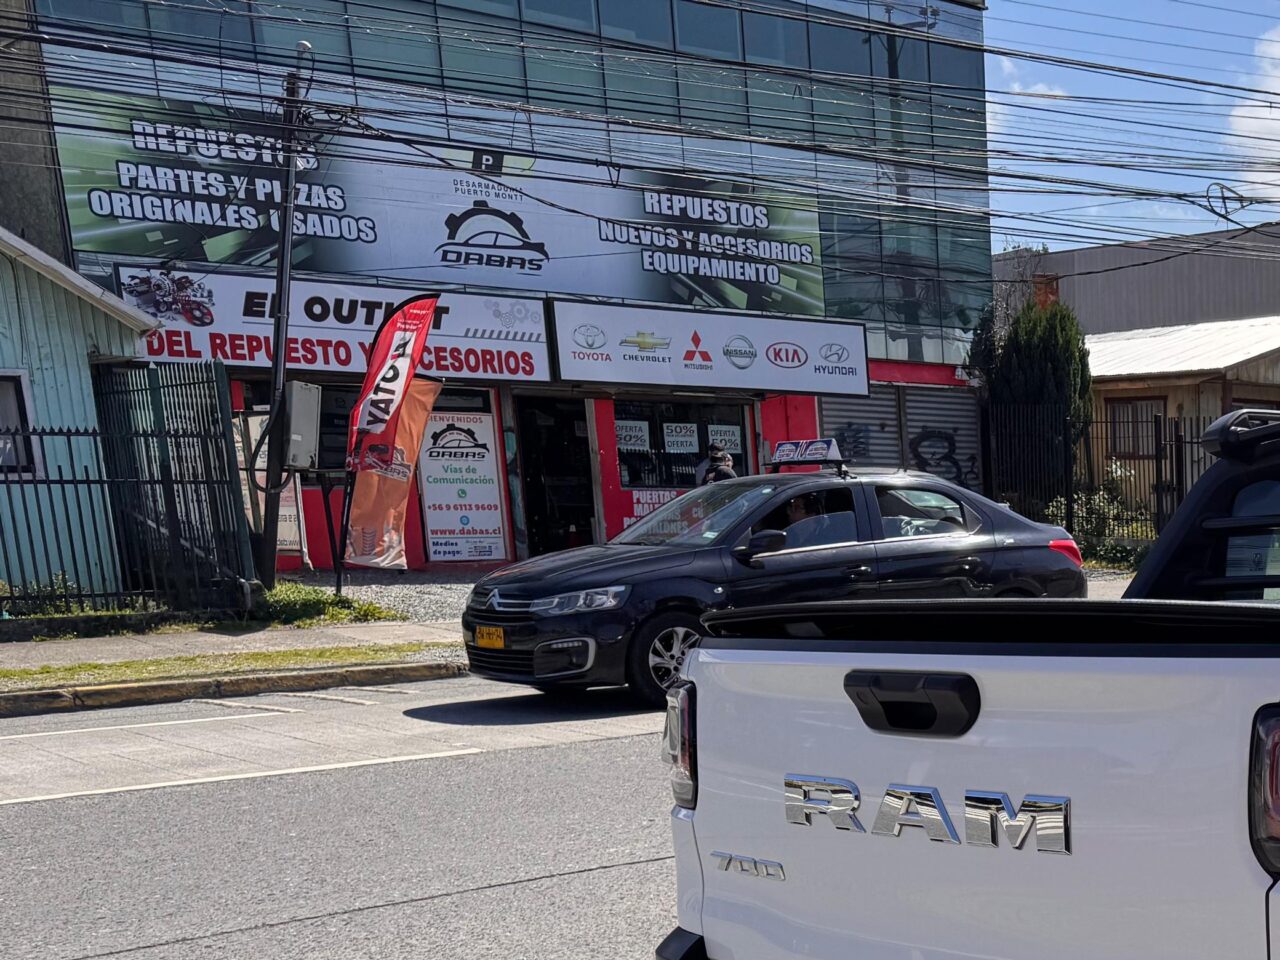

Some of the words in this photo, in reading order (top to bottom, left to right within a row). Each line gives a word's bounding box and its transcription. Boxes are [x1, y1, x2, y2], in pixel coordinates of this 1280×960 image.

[116, 160, 227, 198] PARTES
[230, 174, 248, 199] Y
[255, 178, 345, 211] PIZAS
[454, 187, 491, 198] PUERTO
[494, 192, 524, 201] MONTT
[88, 188, 261, 230] ORIGINALES
[643, 190, 768, 229] REPUESTOS
[598, 219, 680, 249] NUEVOS
[681, 230, 695, 249] Y
[698, 232, 814, 264] ACCESORIOS
[440, 249, 543, 271] DABAS
[641, 248, 780, 285] EQUIPAMIENTO
[146, 330, 202, 359] DEL
[420, 346, 535, 377] CESORIOS
[571, 351, 612, 362] TOYOTA
[622, 353, 672, 363] CHEVROLET
[725, 347, 755, 357] NISSAN
[773, 347, 802, 363] KIA
[814, 364, 857, 376] HYUNDAI
[366, 364, 400, 427] YATO
[430, 415, 484, 424] IENVENIDOS
[615, 425, 643, 433] OFERTA
[666, 424, 695, 434] 50%
[710, 429, 736, 438] OFERTA
[615, 433, 647, 443] 50%
[667, 440, 694, 448] OFERTA
[428, 450, 486, 459] DABAS
[442, 464, 463, 474] Vías
[465, 465, 477, 474] de
[426, 474, 495, 485] Comunicación
[632, 490, 677, 504] PUERTAS
[430, 527, 501, 535] www.dabas.cl
[784, 772, 1072, 856] RAM
[709, 850, 787, 882] 700
